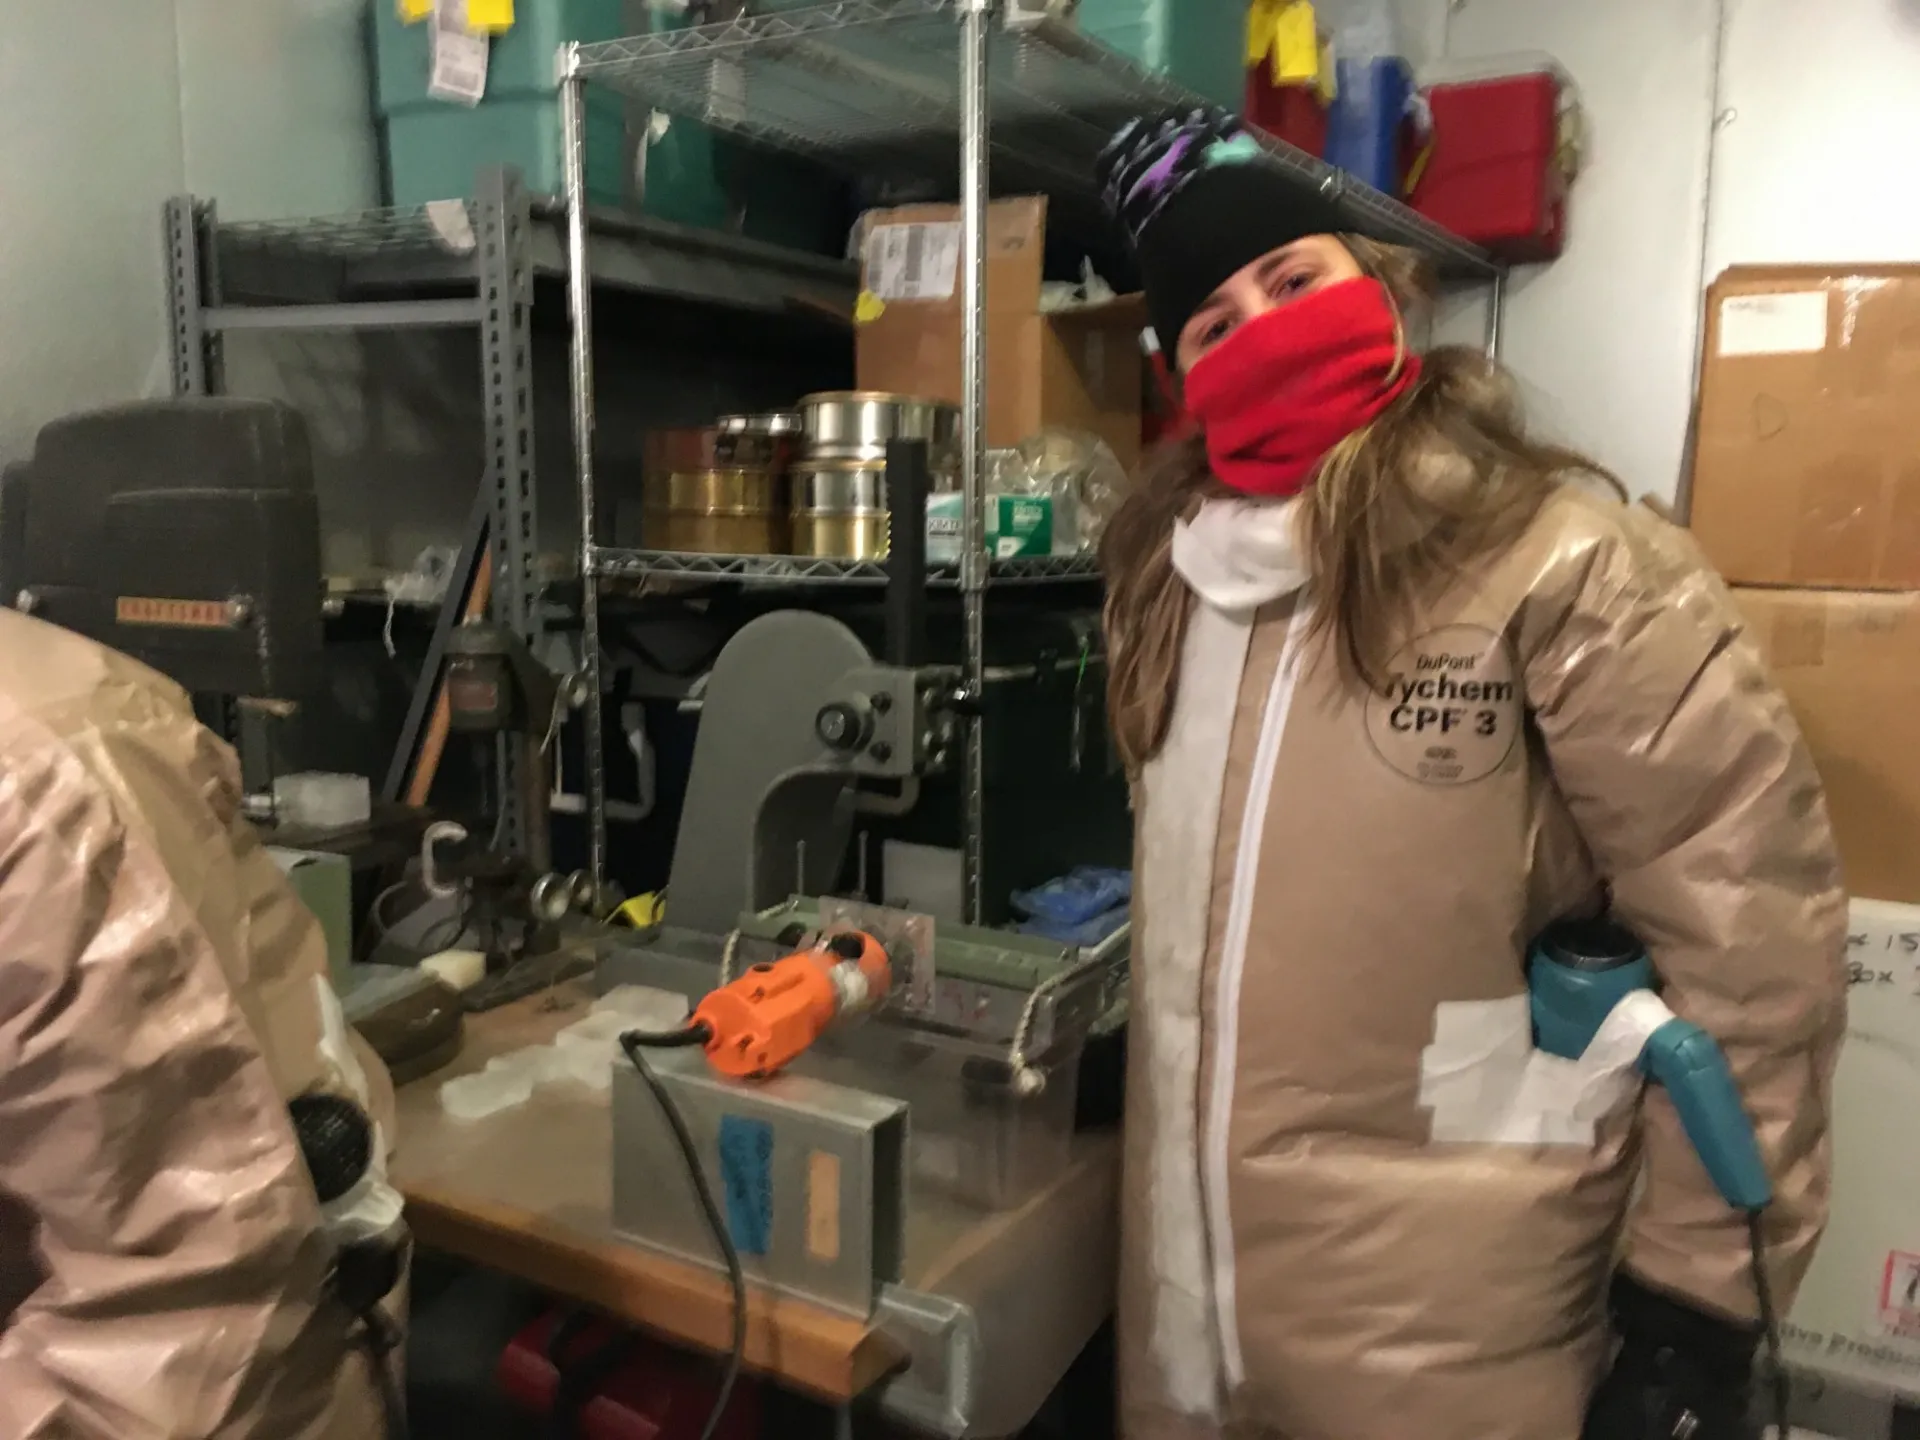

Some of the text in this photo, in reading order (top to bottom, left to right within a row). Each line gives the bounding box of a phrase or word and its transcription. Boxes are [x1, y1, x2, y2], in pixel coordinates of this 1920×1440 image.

[1416, 653, 1477, 670] DuPont
[1390, 704, 1499, 736] CPF 3
